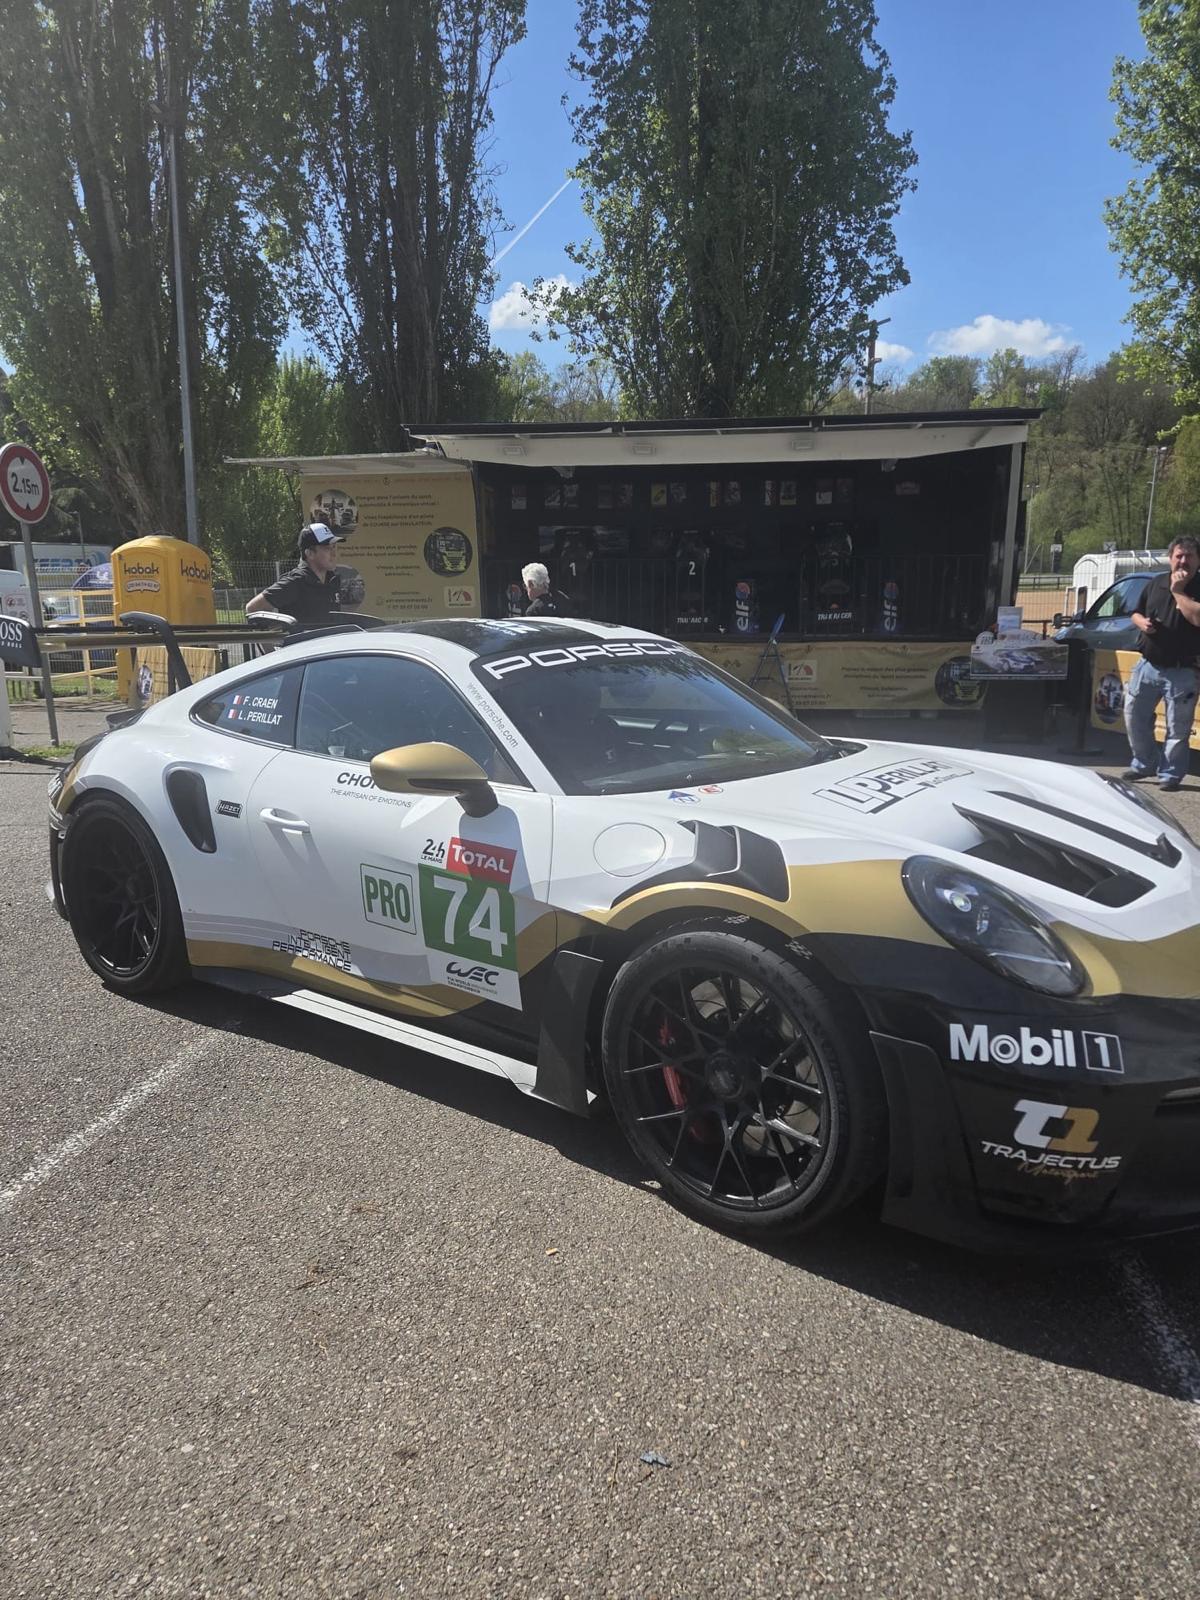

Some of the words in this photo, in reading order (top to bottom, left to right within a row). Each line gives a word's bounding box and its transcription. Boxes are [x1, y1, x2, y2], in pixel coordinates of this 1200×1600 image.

[11, 471, 40, 496] 2.15m
[123, 562, 160, 575] kobak
[689, 561, 696, 576] 2
[735, 600, 749, 631] elf
[0, 621, 23, 642] OSS
[481, 642, 691, 680] PORSCH
[252, 697, 279, 709] CRAEN
[467, 682, 519, 749] www.porsche.com
[246, 711, 283, 725] PERILLAT
[336, 772, 375, 789] CHO
[330, 788, 342, 796] THE
[342, 790, 369, 801] ARTISAN
[368, 794, 378, 802] OF
[377, 796, 412, 808] EMOTIONS
[428, 855, 443, 864] MANS
[452, 844, 510, 874] TOTAL
[364, 875, 411, 924] PRO
[433, 875, 508, 957] 74
[300, 929, 350, 952] PORSCHE
[272, 940, 352, 972] PERFORMANCE
[446, 961, 499, 986] WEC
[949, 1023, 1077, 1067] Mobil
[1094, 1036, 1111, 1067] 1
[981, 1140, 1122, 1169] TRAJECTUS
